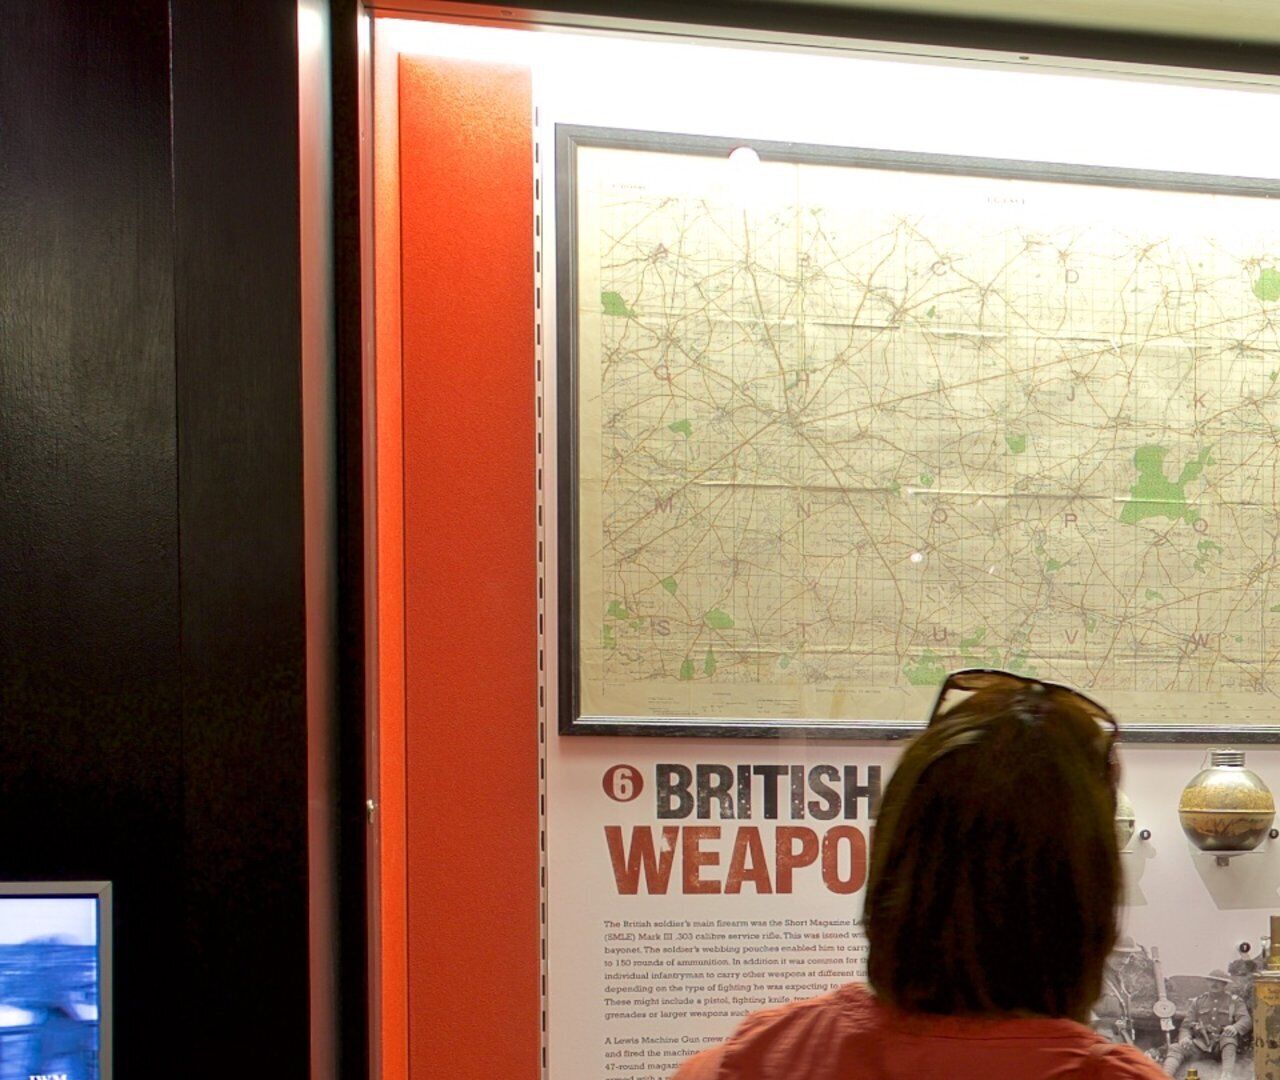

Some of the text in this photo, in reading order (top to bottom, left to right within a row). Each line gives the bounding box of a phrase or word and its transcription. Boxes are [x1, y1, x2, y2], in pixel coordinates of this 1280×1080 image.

[613, 764, 881, 820] 6 BRITISH
[604, 825, 867, 895] WEAPO
[604, 920, 620, 928] The
[623, 920, 651, 928] British
[716, 919, 748, 928] firearm
[809, 919, 850, 928] Magazine
[604, 933, 635, 942] (SMLE)
[696, 932, 725, 940] calibre
[728, 932, 760, 940] service
[702, 945, 740, 954] webbing
[743, 945, 779, 953] pouches
